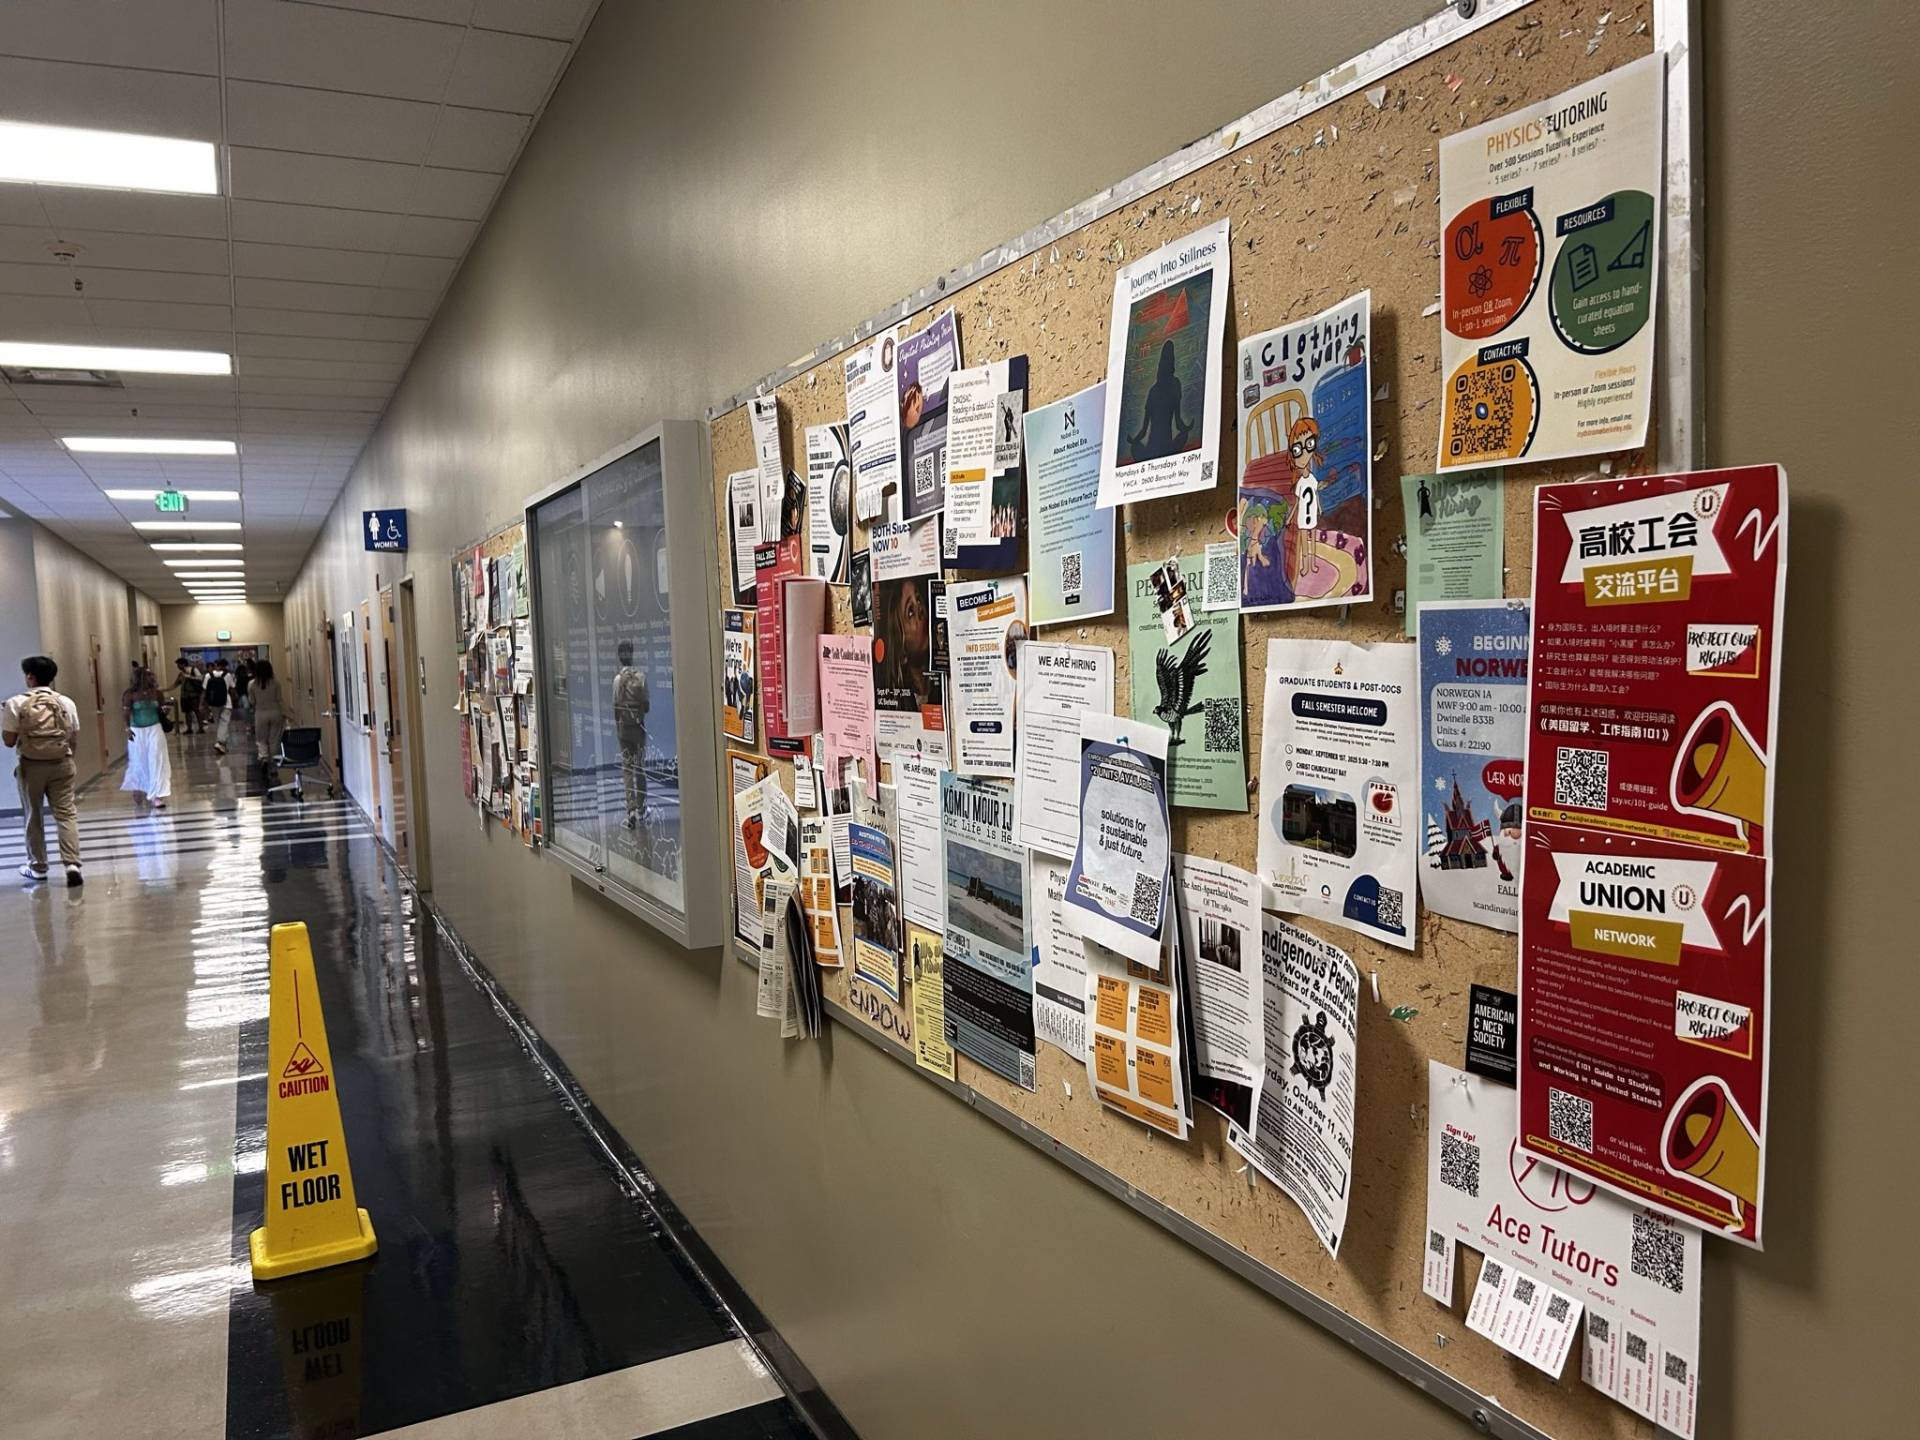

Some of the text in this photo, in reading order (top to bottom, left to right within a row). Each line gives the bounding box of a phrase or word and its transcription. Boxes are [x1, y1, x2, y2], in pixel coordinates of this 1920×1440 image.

[1487, 92, 1607, 155] PHYSICS TUTORING
[1489, 123, 1605, 174] Over 500 Sessions Tutoring Experience
[1496, 196, 1528, 214] FLEXIBLE
[1564, 207, 1606, 231] RESOURCES
[1131, 269, 1157, 292] Journey
[1160, 260, 1177, 275] Into
[1180, 242, 1217, 267] Stillness
[1452, 301, 1493, 321] In-person OR
[1573, 291, 1612, 311] Gain access
[1481, 314, 1507, 328] sessions
[1577, 301, 1635, 324] curated equation
[1261, 313, 1359, 367] Clothing
[1593, 324, 1617, 338] sheets
[1484, 343, 1523, 361] CONTACT ME
[1115, 460, 1177, 479] Mondays Thursdays
[872, 523, 891, 540] BOTH
[1579, 511, 1698, 560] 高校工会
[374, 541, 399, 549] WOMEN
[872, 538, 899, 554] NOW 10
[1594, 568, 1680, 600] 交流平台
[959, 595, 985, 609] BECOME
[1687, 629, 1730, 646] PROTECT
[1038, 655, 1097, 672] WE ARE HIRING
[1699, 649, 1738, 668] RIGHTS
[1279, 676, 1401, 695] GRADUATE STUDENTS POST-DOCS
[1436, 687, 1478, 699] NORWEGN
[1301, 700, 1378, 718] FALL SEMESTER WELCOME
[1436, 701, 1522, 714] MWF 9:00 am 10:00
[1436, 713, 1495, 726] Dwinelle B33B
[1436, 726, 1466, 738] Units: 4
[1436, 738, 1492, 752] Class 22190
[1370, 782, 1396, 793] PIZZA
[1487, 771, 1506, 785] LÆR
[972, 794, 999, 829] MOUR
[1611, 796, 1669, 811] say.vc/101-guide
[943, 814, 997, 840] Our Life is
[1100, 809, 1146, 832] solutions for
[1104, 836, 1119, 852] just
[1106, 823, 1148, 848] sustainable
[1585, 860, 1656, 880] ACADEMIC
[1497, 884, 1518, 897] FALL
[1580, 881, 1666, 914] UNION
[1280, 922, 1344, 964] Berkeley's 33rd
[1594, 929, 1657, 949] NETWORK
[1262, 929, 1328, 980] ndigenous
[1285, 961, 1311, 985] Wow
[1313, 979, 1321, 993] &
[1262, 964, 1343, 1024] 533 Years of Resistance
[1474, 1003, 1515, 1024] AMERICAN
[1677, 997, 1720, 1022] PROTECT
[1473, 1017, 1504, 1036] CNCER
[1688, 1020, 1729, 1042] RIGHTS
[1473, 1030, 1506, 1049] SOCIETY
[279, 1075, 329, 1099] CAUTION
[1539, 1061, 1629, 1097] and Working the United
[1594, 1066, 1661, 1097] Guide to Studying
[1283, 1095, 1292, 1108] 10
[1292, 1101, 1304, 1117] AM
[1292, 1085, 1327, 1123] October
[1445, 1122, 1477, 1143] Sign Up!
[1610, 1135, 1618, 1143] or
[1618, 1137, 1629, 1147] via
[287, 1140, 328, 1173] WET
[1597, 1144, 1666, 1176] say.vc/101-guide-en
[281, 1174, 341, 1210] FLOOR
[1488, 1203, 1619, 1288] Ace Tutors
[1511, 1249, 1539, 1269] Chemistry
